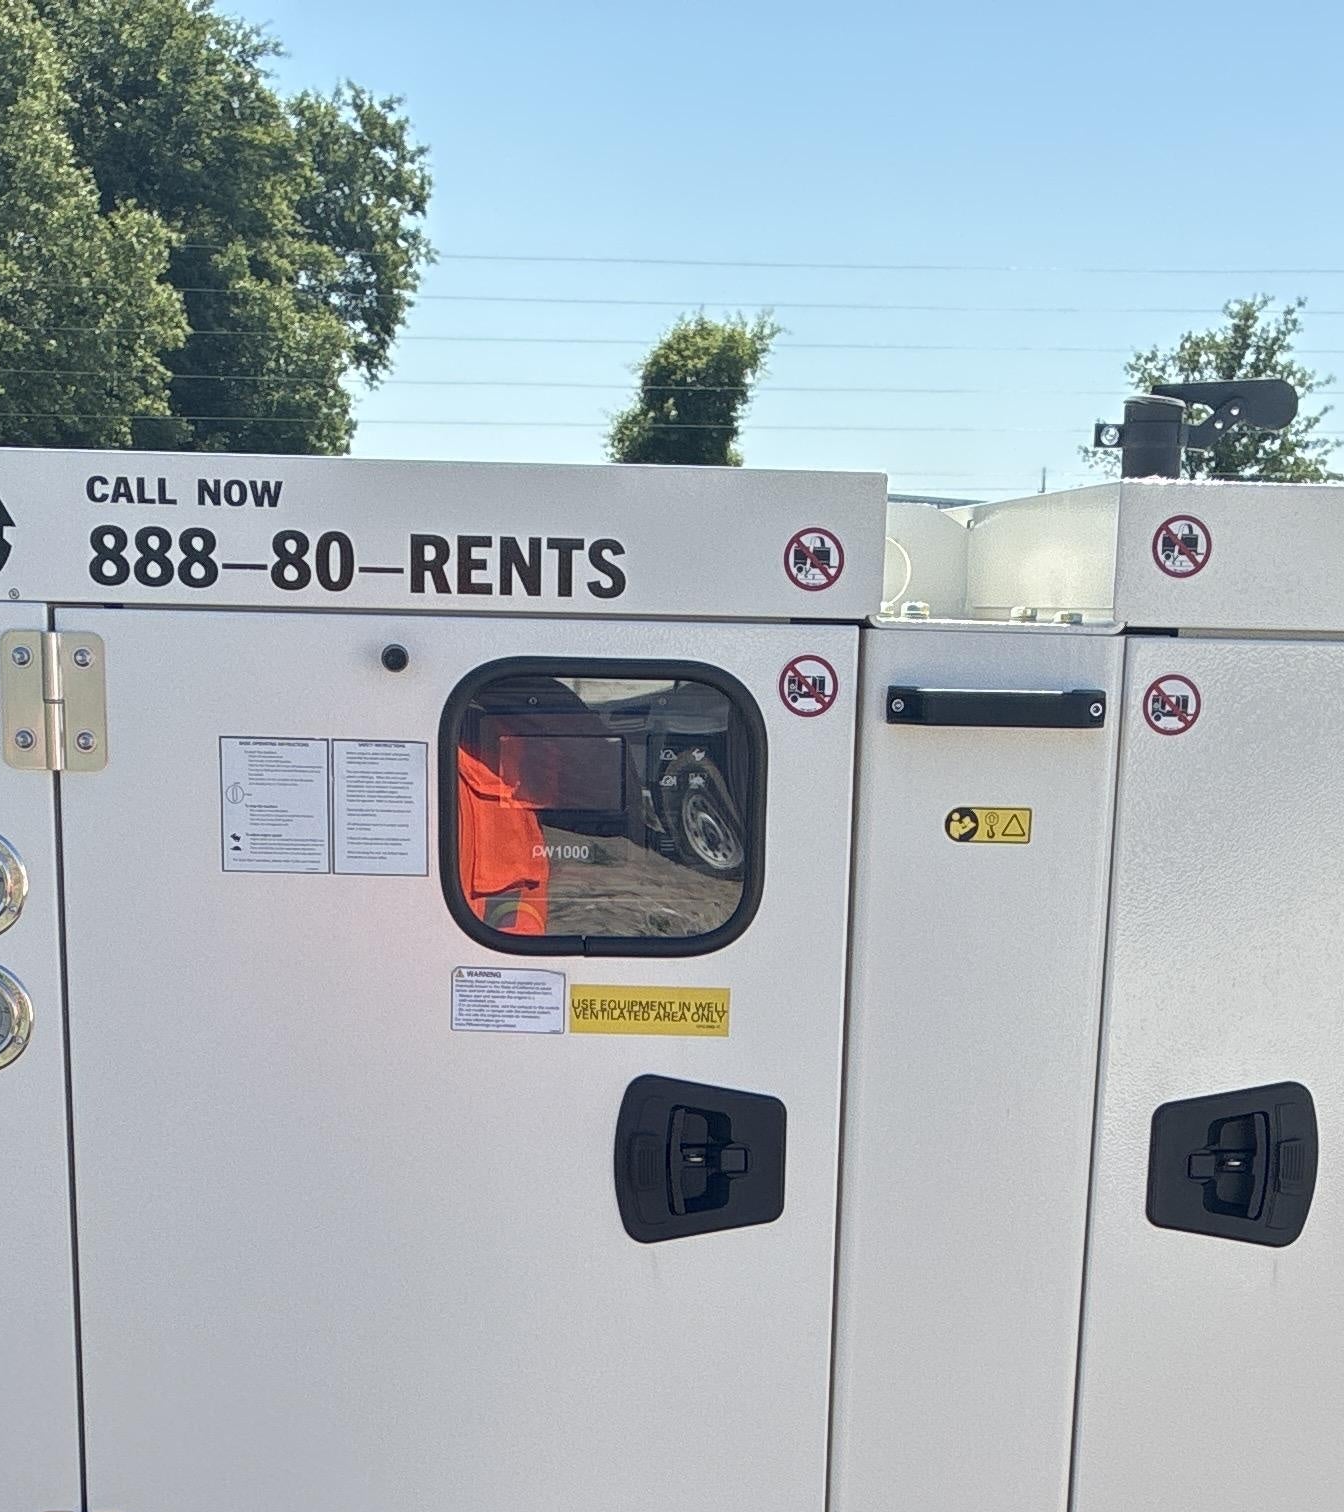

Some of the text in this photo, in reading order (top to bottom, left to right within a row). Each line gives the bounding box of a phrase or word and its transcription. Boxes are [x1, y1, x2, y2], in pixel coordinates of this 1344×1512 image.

[86, 475, 284, 508] CALL NOW
[466, 971, 502, 979] WARNING
[571, 999, 728, 1014] USE EQUIPMENT IN WELL
[574, 1009, 726, 1023] VENTILATED AREA ONLY
